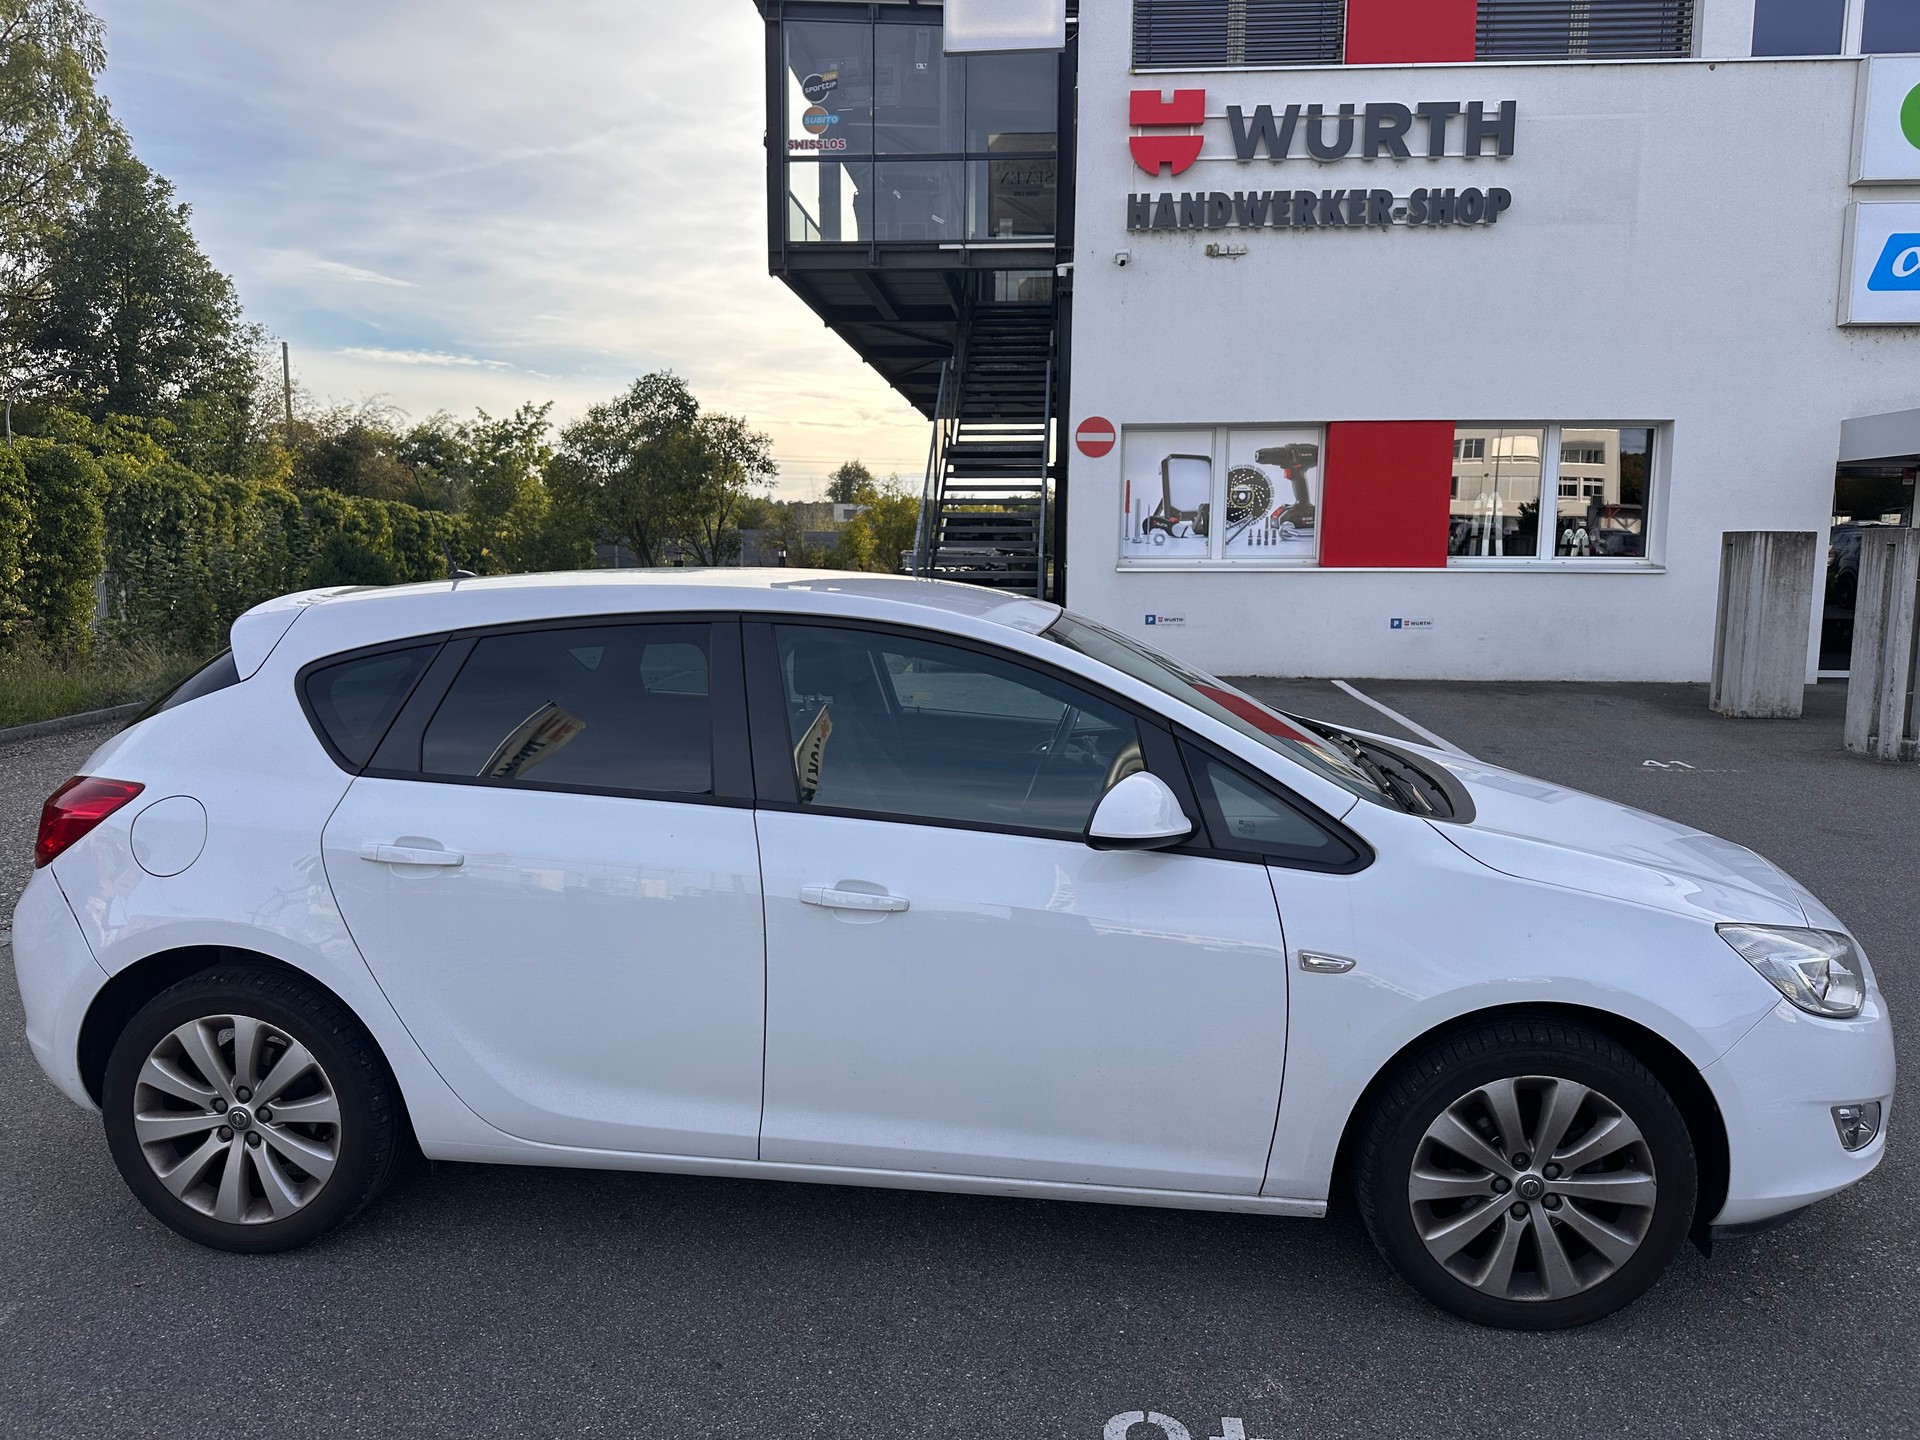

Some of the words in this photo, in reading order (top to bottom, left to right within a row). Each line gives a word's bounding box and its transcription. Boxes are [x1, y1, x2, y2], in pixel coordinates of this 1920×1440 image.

[804, 116, 839, 125] SUBITO
[787, 138, 846, 150] SWISSLOS
[1127, 187, 1512, 231] HANDWERKER-SHOP
